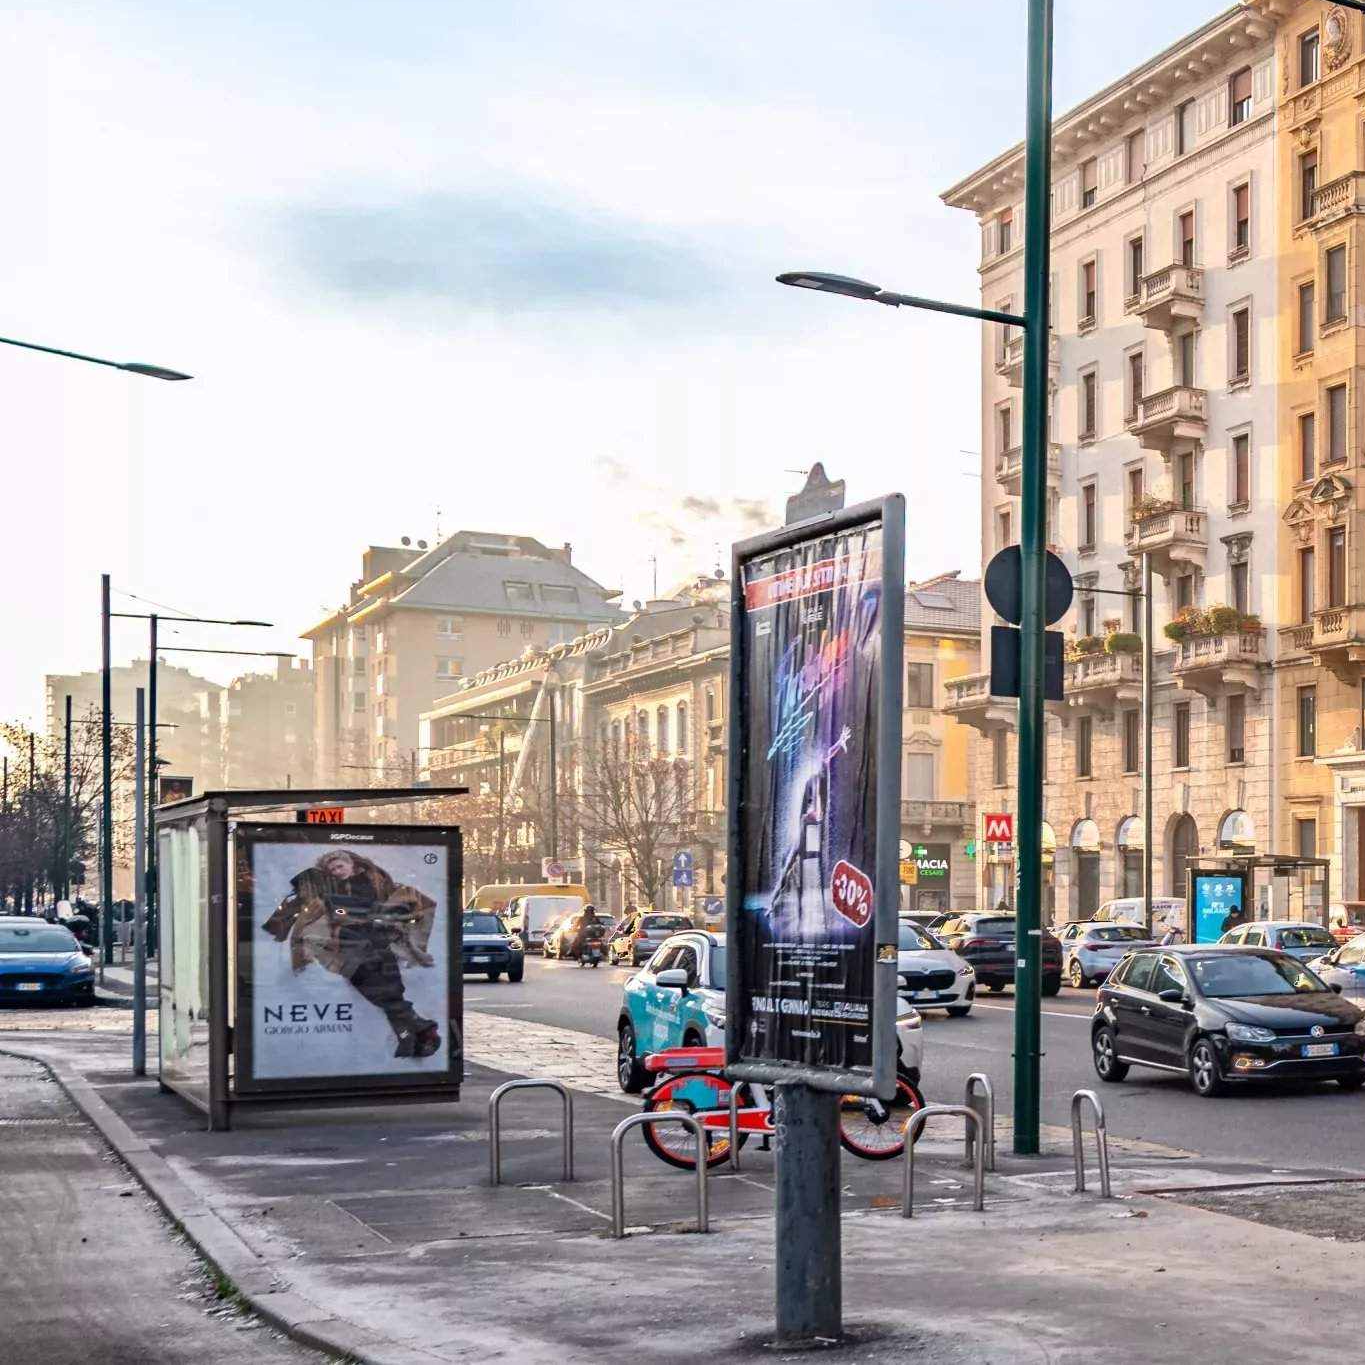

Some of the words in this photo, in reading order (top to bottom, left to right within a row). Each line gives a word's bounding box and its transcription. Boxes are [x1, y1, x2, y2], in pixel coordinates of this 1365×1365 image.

[310, 810, 342, 823] TAXI
[913, 859, 948, 869] MACIA
[834, 875, 868, 916] -30%
[264, 1003, 353, 1023] NEVE
[264, 1025, 310, 1035] GIORGIO
[314, 1023, 353, 1034] ARMANI
